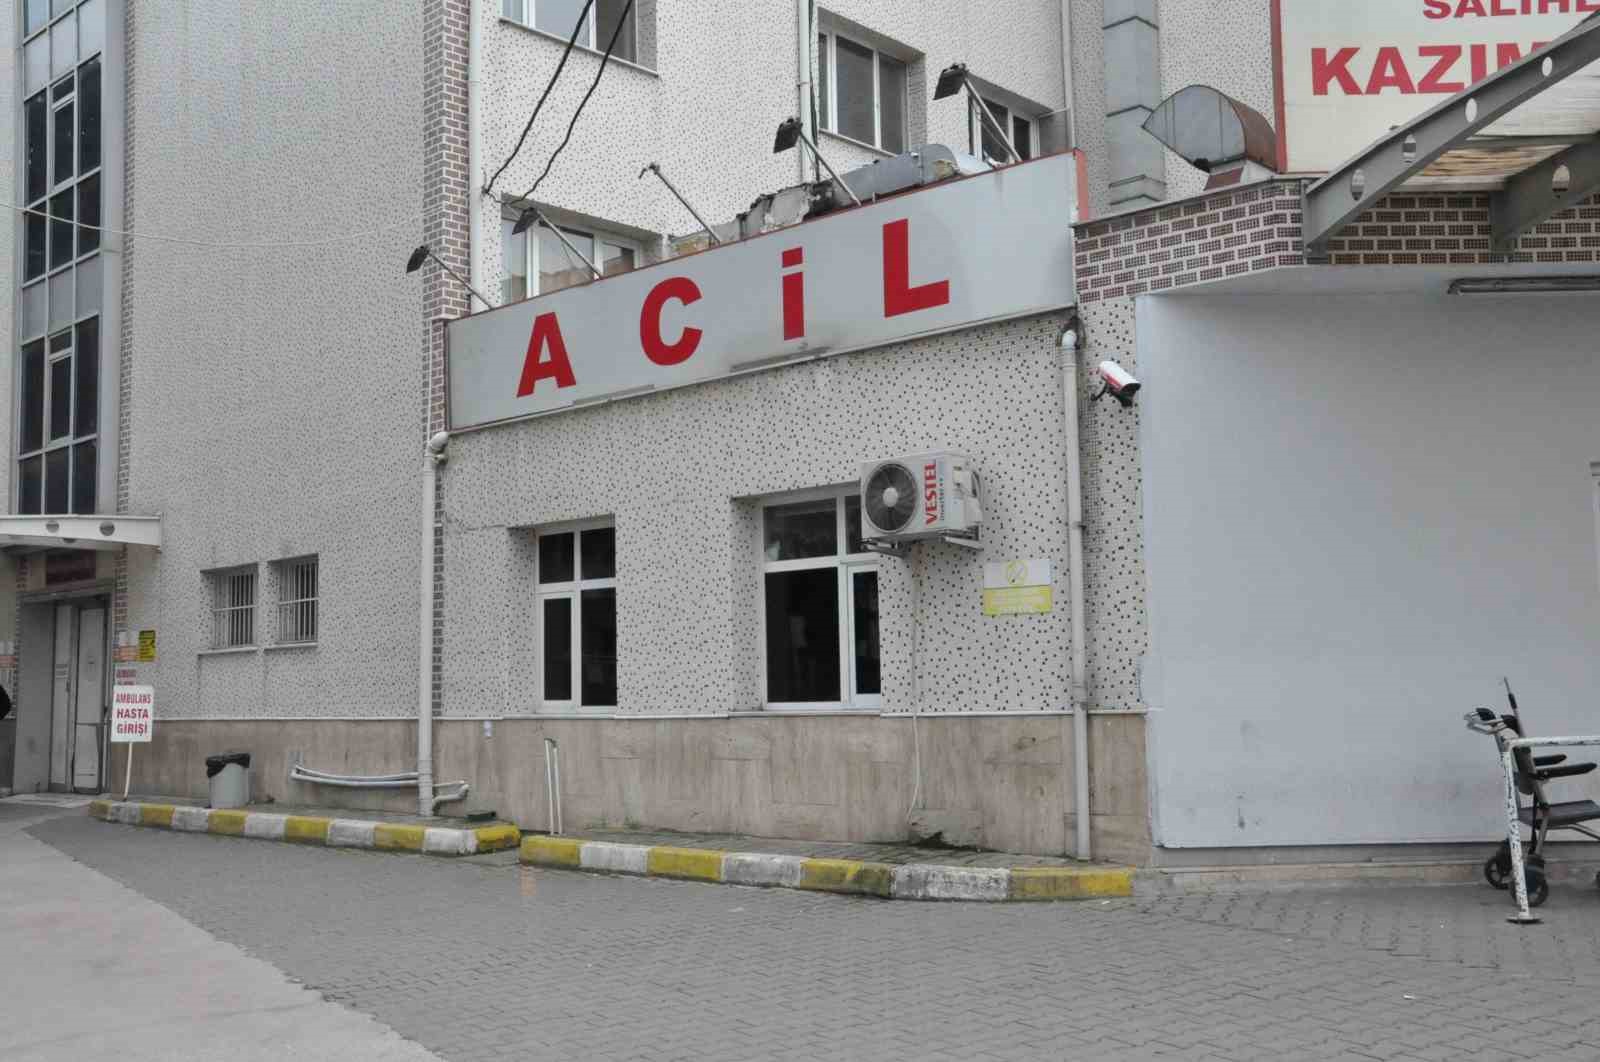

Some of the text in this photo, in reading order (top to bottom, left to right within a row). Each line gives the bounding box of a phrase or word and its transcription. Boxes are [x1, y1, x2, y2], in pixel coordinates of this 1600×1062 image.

[924, 459, 938, 525] VESTEL
[115, 692, 151, 704] AMBULANS
[117, 708, 149, 719] HASTA
